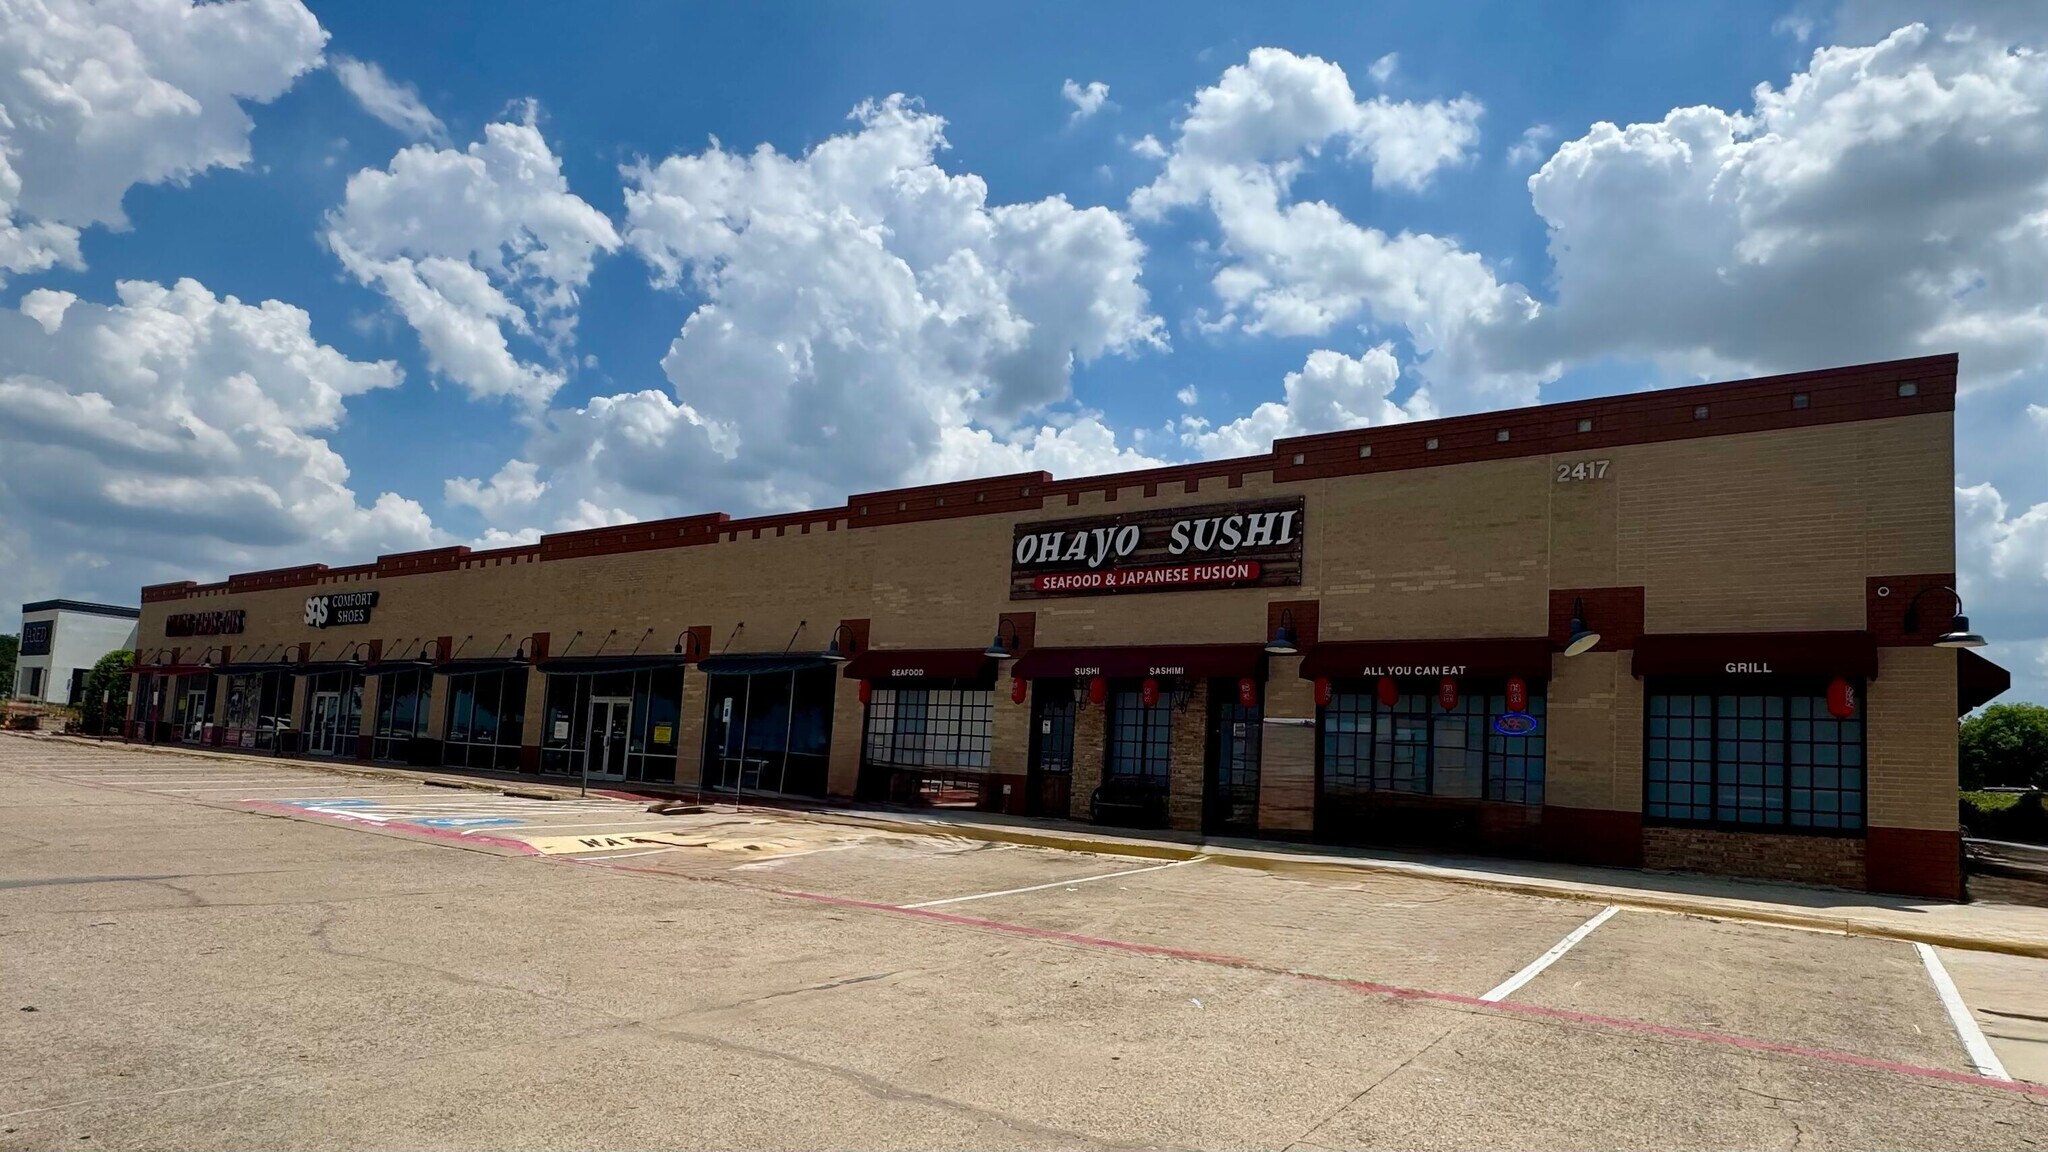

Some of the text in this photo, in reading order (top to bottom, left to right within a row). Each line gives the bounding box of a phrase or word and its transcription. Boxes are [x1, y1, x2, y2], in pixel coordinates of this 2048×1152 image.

[1557, 460, 1610, 482] 2417
[1016, 510, 1298, 568] OHAYO SUSHI
[1042, 564, 1250, 589] SEAFOOD & JAPANESE FUSION
[332, 592, 373, 608] COMFORT
[304, 596, 329, 627] SAS
[337, 609, 365, 623] SHOES
[891, 668, 924, 677] SEAFOOD
[1074, 666, 1101, 677] SUSHI
[1149, 665, 1185, 677] SASHIMI
[1363, 665, 1467, 676] ALL YOU CAN EAT
[1724, 661, 1773, 674] GRILL
